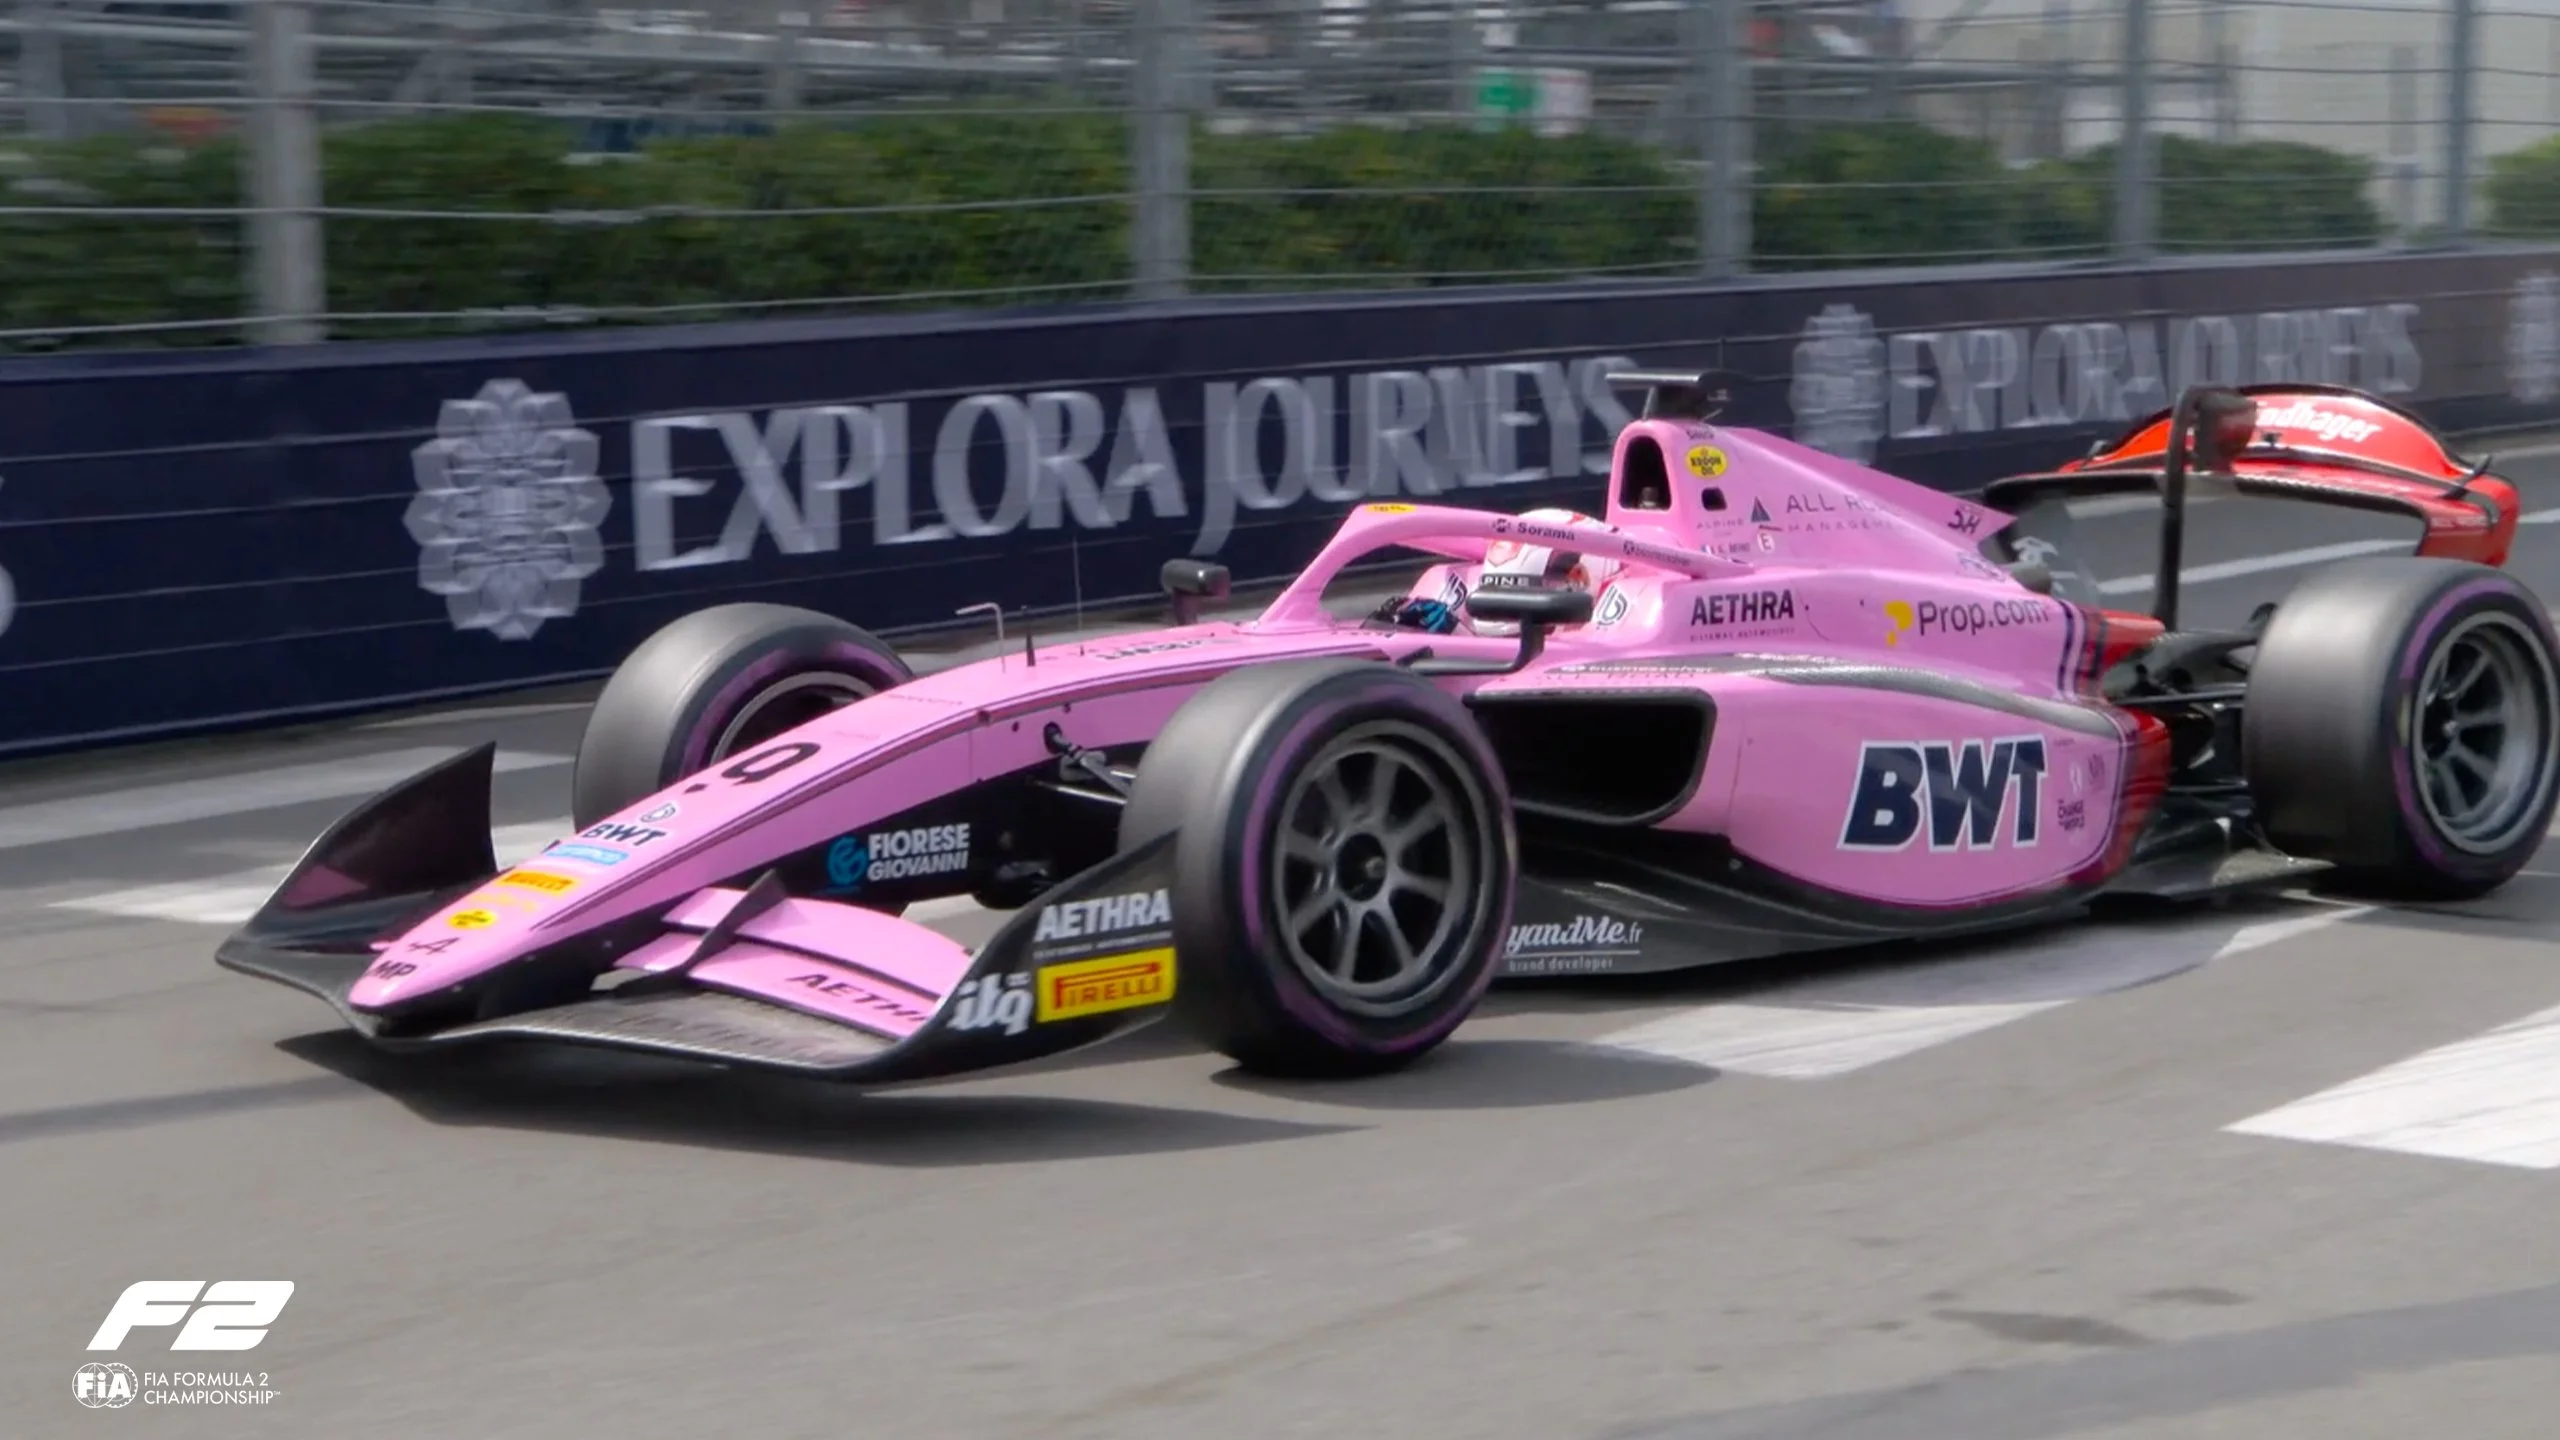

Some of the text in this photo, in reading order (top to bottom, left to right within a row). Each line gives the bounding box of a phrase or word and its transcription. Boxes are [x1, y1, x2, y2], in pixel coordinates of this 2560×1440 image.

[2255, 400, 2384, 443] indhager
[631, 356, 1644, 571] EXPLORA JOURNEYS
[1786, 493, 1836, 514] ALL
[1517, 523, 1576, 542] Sorama
[1484, 576, 1530, 587] PINE
[1691, 590, 1794, 626] AETHRA
[1918, 599, 2049, 635] Prop.com
[1836, 734, 2049, 852] BWT
[583, 823, 668, 846] BWT
[868, 823, 970, 861] FIORESE
[868, 851, 969, 882] GIOVANNI
[1034, 889, 1172, 943] AETHRA
[1505, 915, 1642, 954] yandMe.fr
[1509, 957, 1614, 972] brand developer
[785, 973, 927, 1022] AETH
[1056, 962, 1161, 1010] PIRELLI
